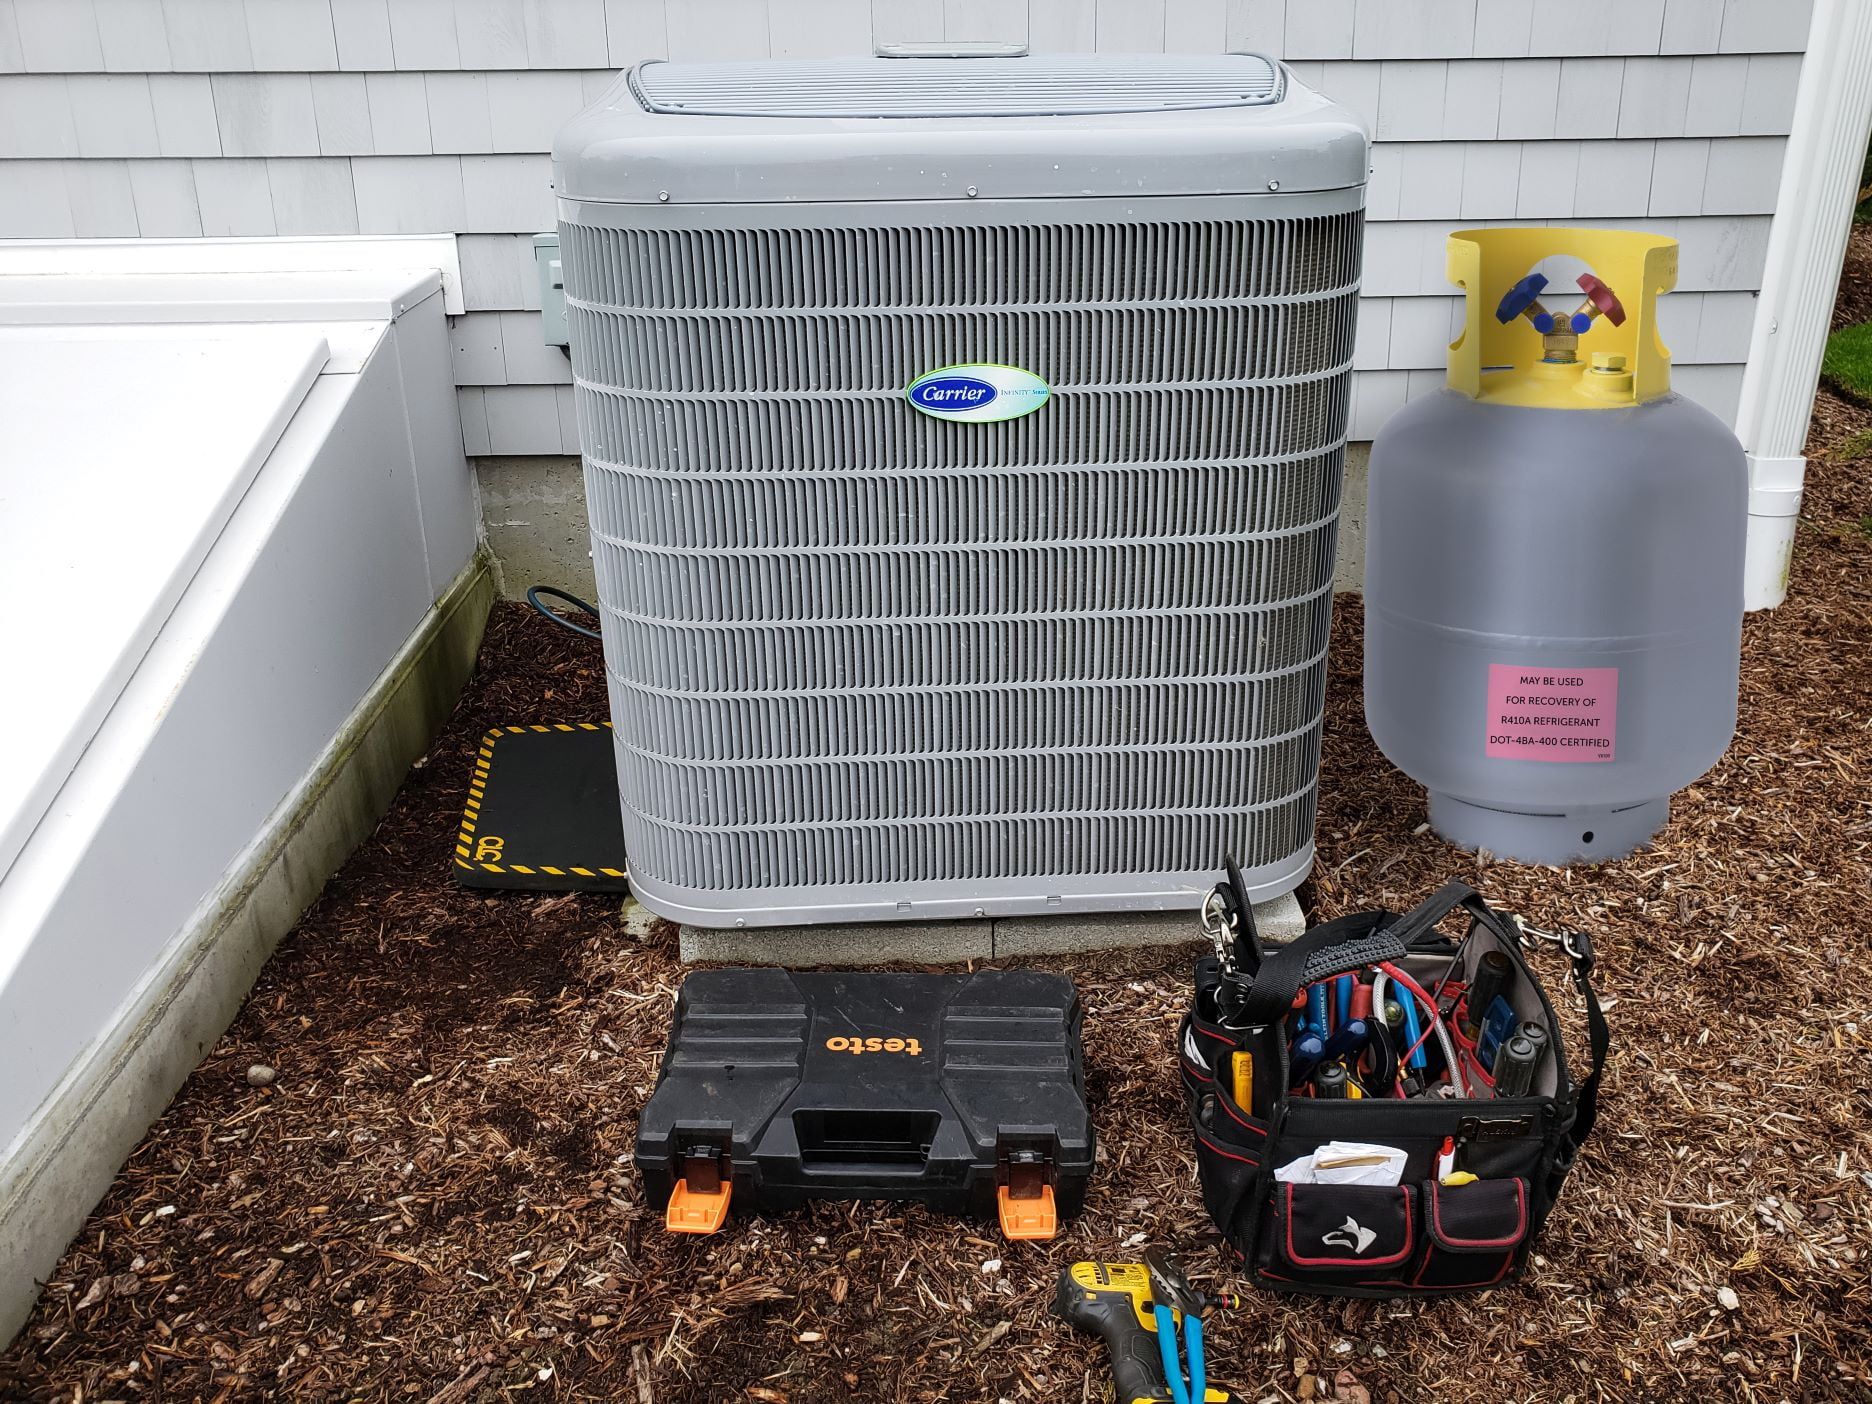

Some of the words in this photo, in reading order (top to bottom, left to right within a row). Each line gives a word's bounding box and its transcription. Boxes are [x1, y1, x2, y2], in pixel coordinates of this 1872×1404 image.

[922, 386, 986, 401] Carrier
[1520, 676, 1540, 685] MAY
[1543, 677, 1554, 686] BE
[1557, 678, 1584, 687] USED
[1506, 696, 1525, 705] FOR
[1528, 697, 1581, 706] RECOVERY
[1582, 698, 1596, 707] OF
[1501, 715, 1531, 725] R410A
[1533, 717, 1601, 727] REFRIGERANT
[1490, 736, 1558, 746] DOT-4BA-400
[1560, 738, 1610, 748] CERTIFIED
[826, 1036, 923, 1056] testo
